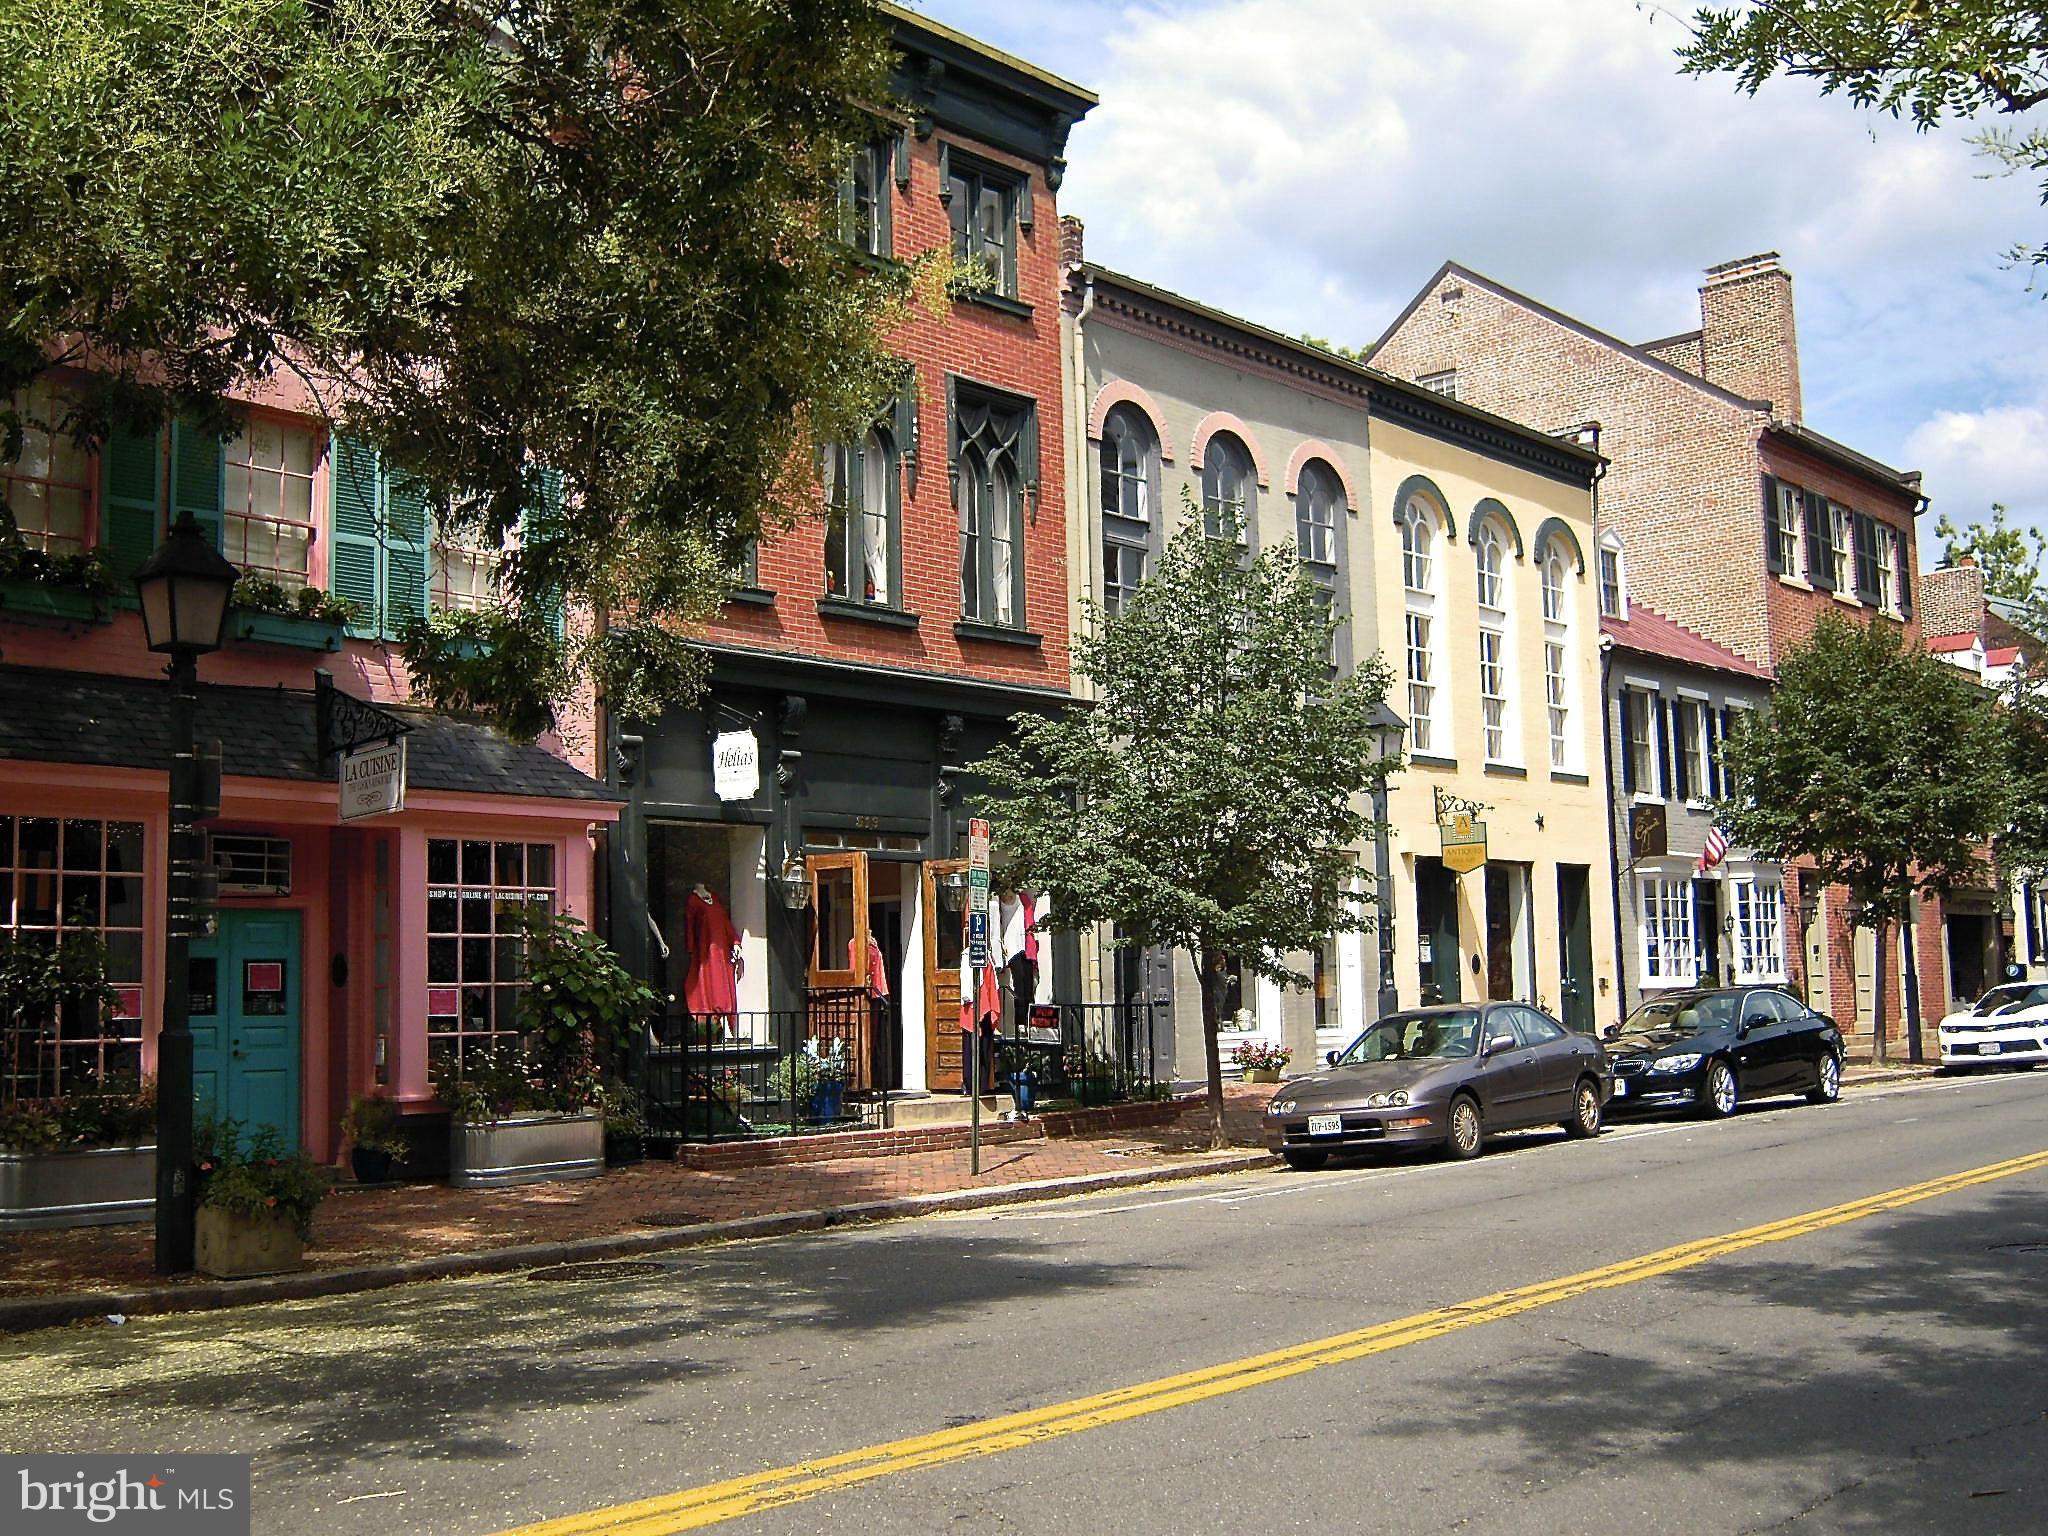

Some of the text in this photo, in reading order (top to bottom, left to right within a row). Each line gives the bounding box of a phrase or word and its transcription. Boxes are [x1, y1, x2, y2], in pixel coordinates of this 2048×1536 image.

[345, 753, 397, 782] LA CUISINE
[429, 890, 446, 898] SHOP
[462, 891, 481, 899] ONLINE
[976, 914, 982, 931] P
